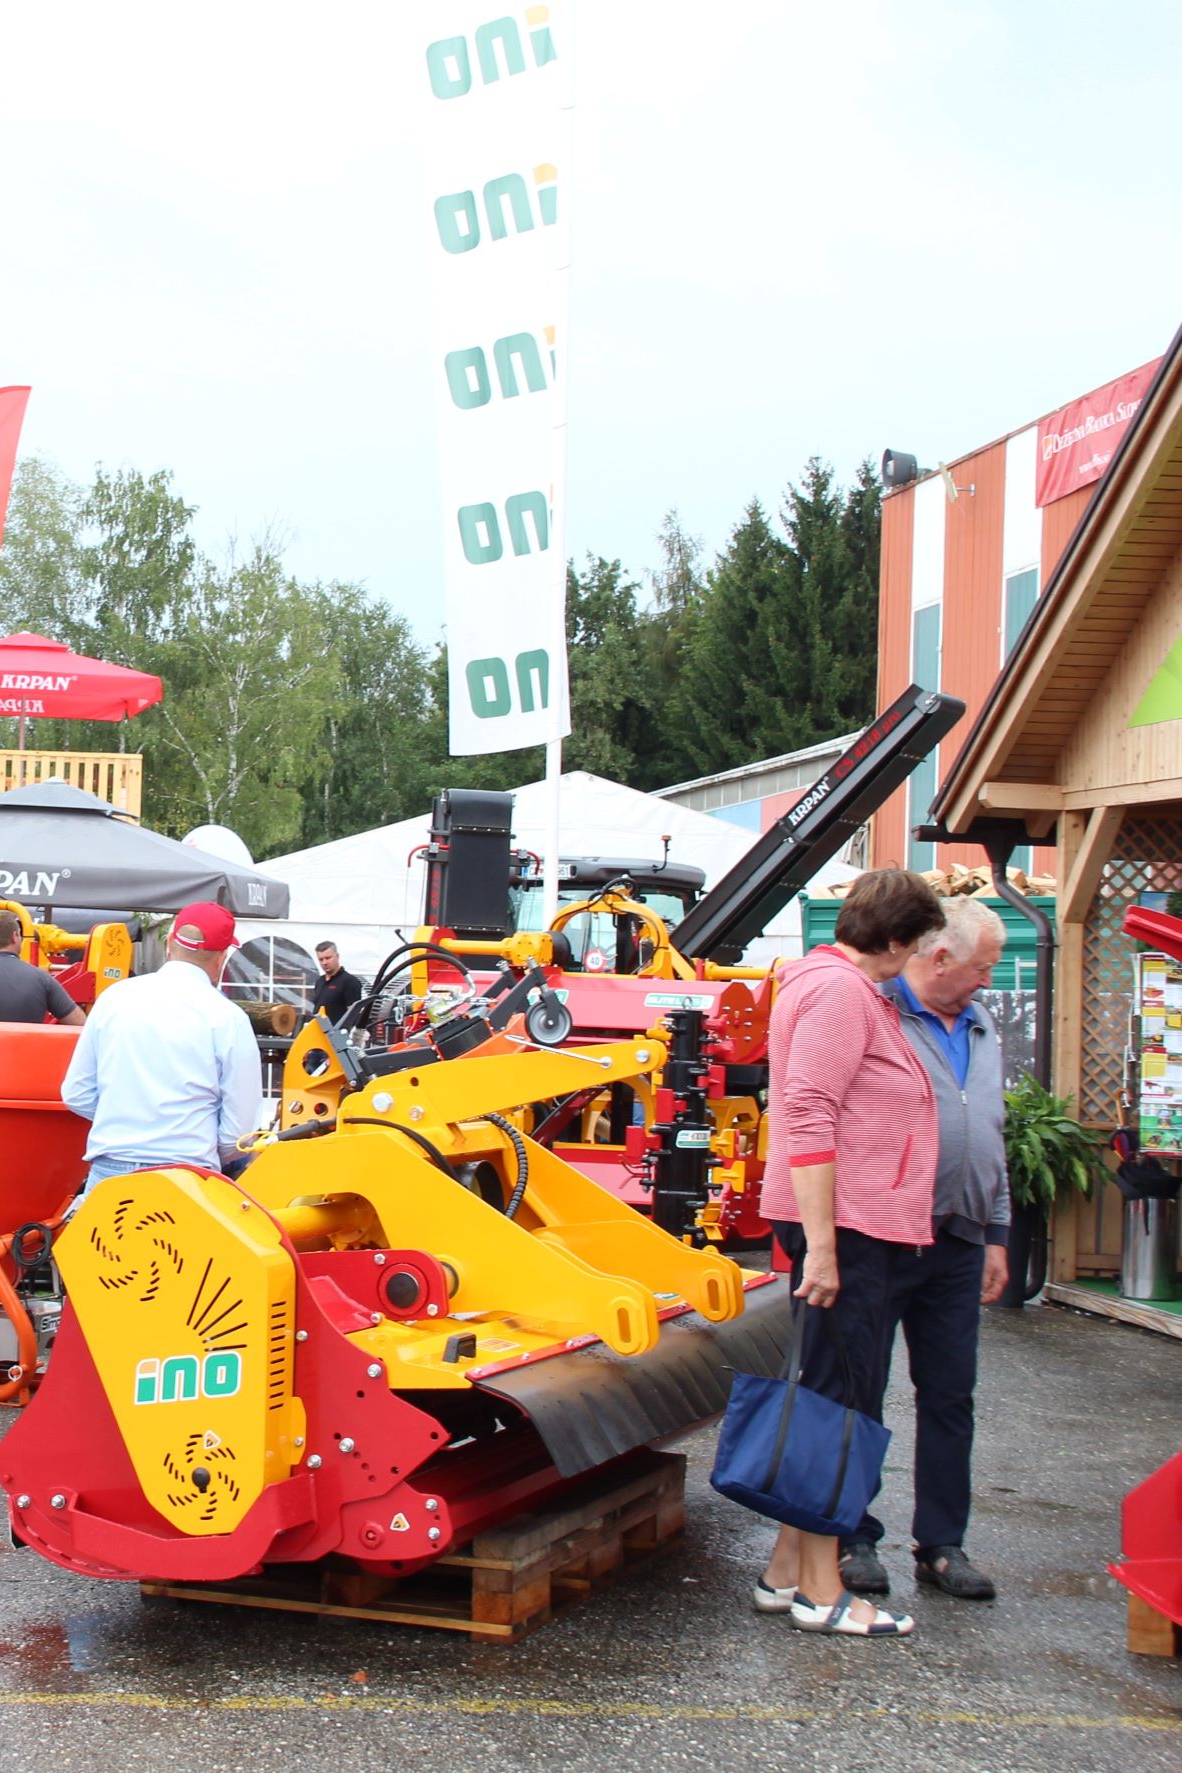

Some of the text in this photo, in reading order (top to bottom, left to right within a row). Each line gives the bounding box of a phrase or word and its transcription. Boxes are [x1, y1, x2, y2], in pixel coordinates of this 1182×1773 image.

[0, 674, 72, 691] KRPAN
[788, 780, 831, 826] KRPAN
[135, 1351, 242, 1405] ino
